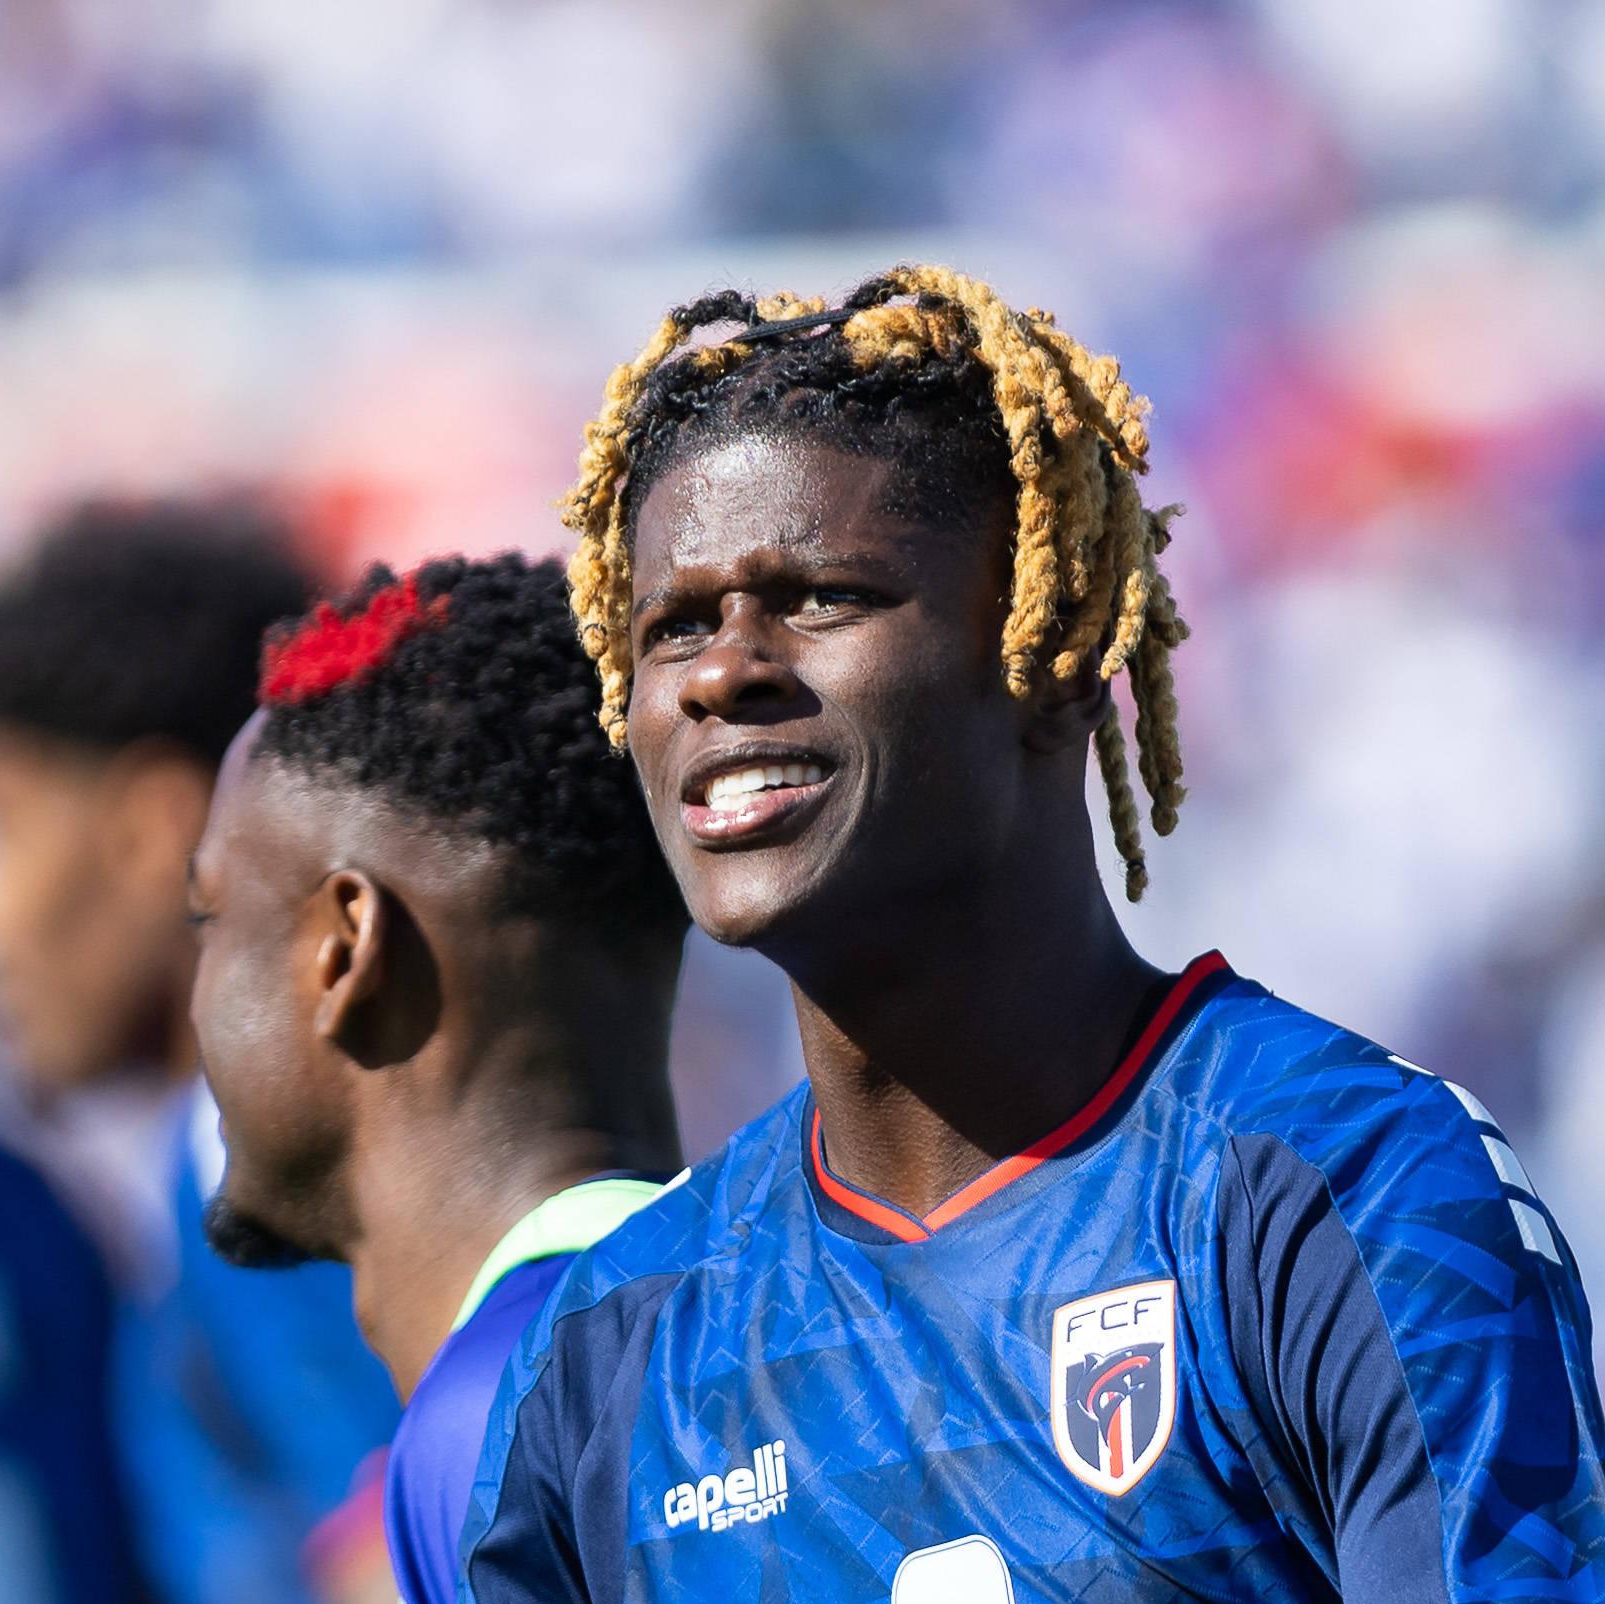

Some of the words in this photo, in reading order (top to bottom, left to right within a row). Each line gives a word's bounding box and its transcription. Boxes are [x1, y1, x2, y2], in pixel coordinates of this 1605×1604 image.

[1067, 1297, 1162, 1343] FCF
[664, 1440, 788, 1531] capelli
[711, 1491, 789, 1532] SPORT
